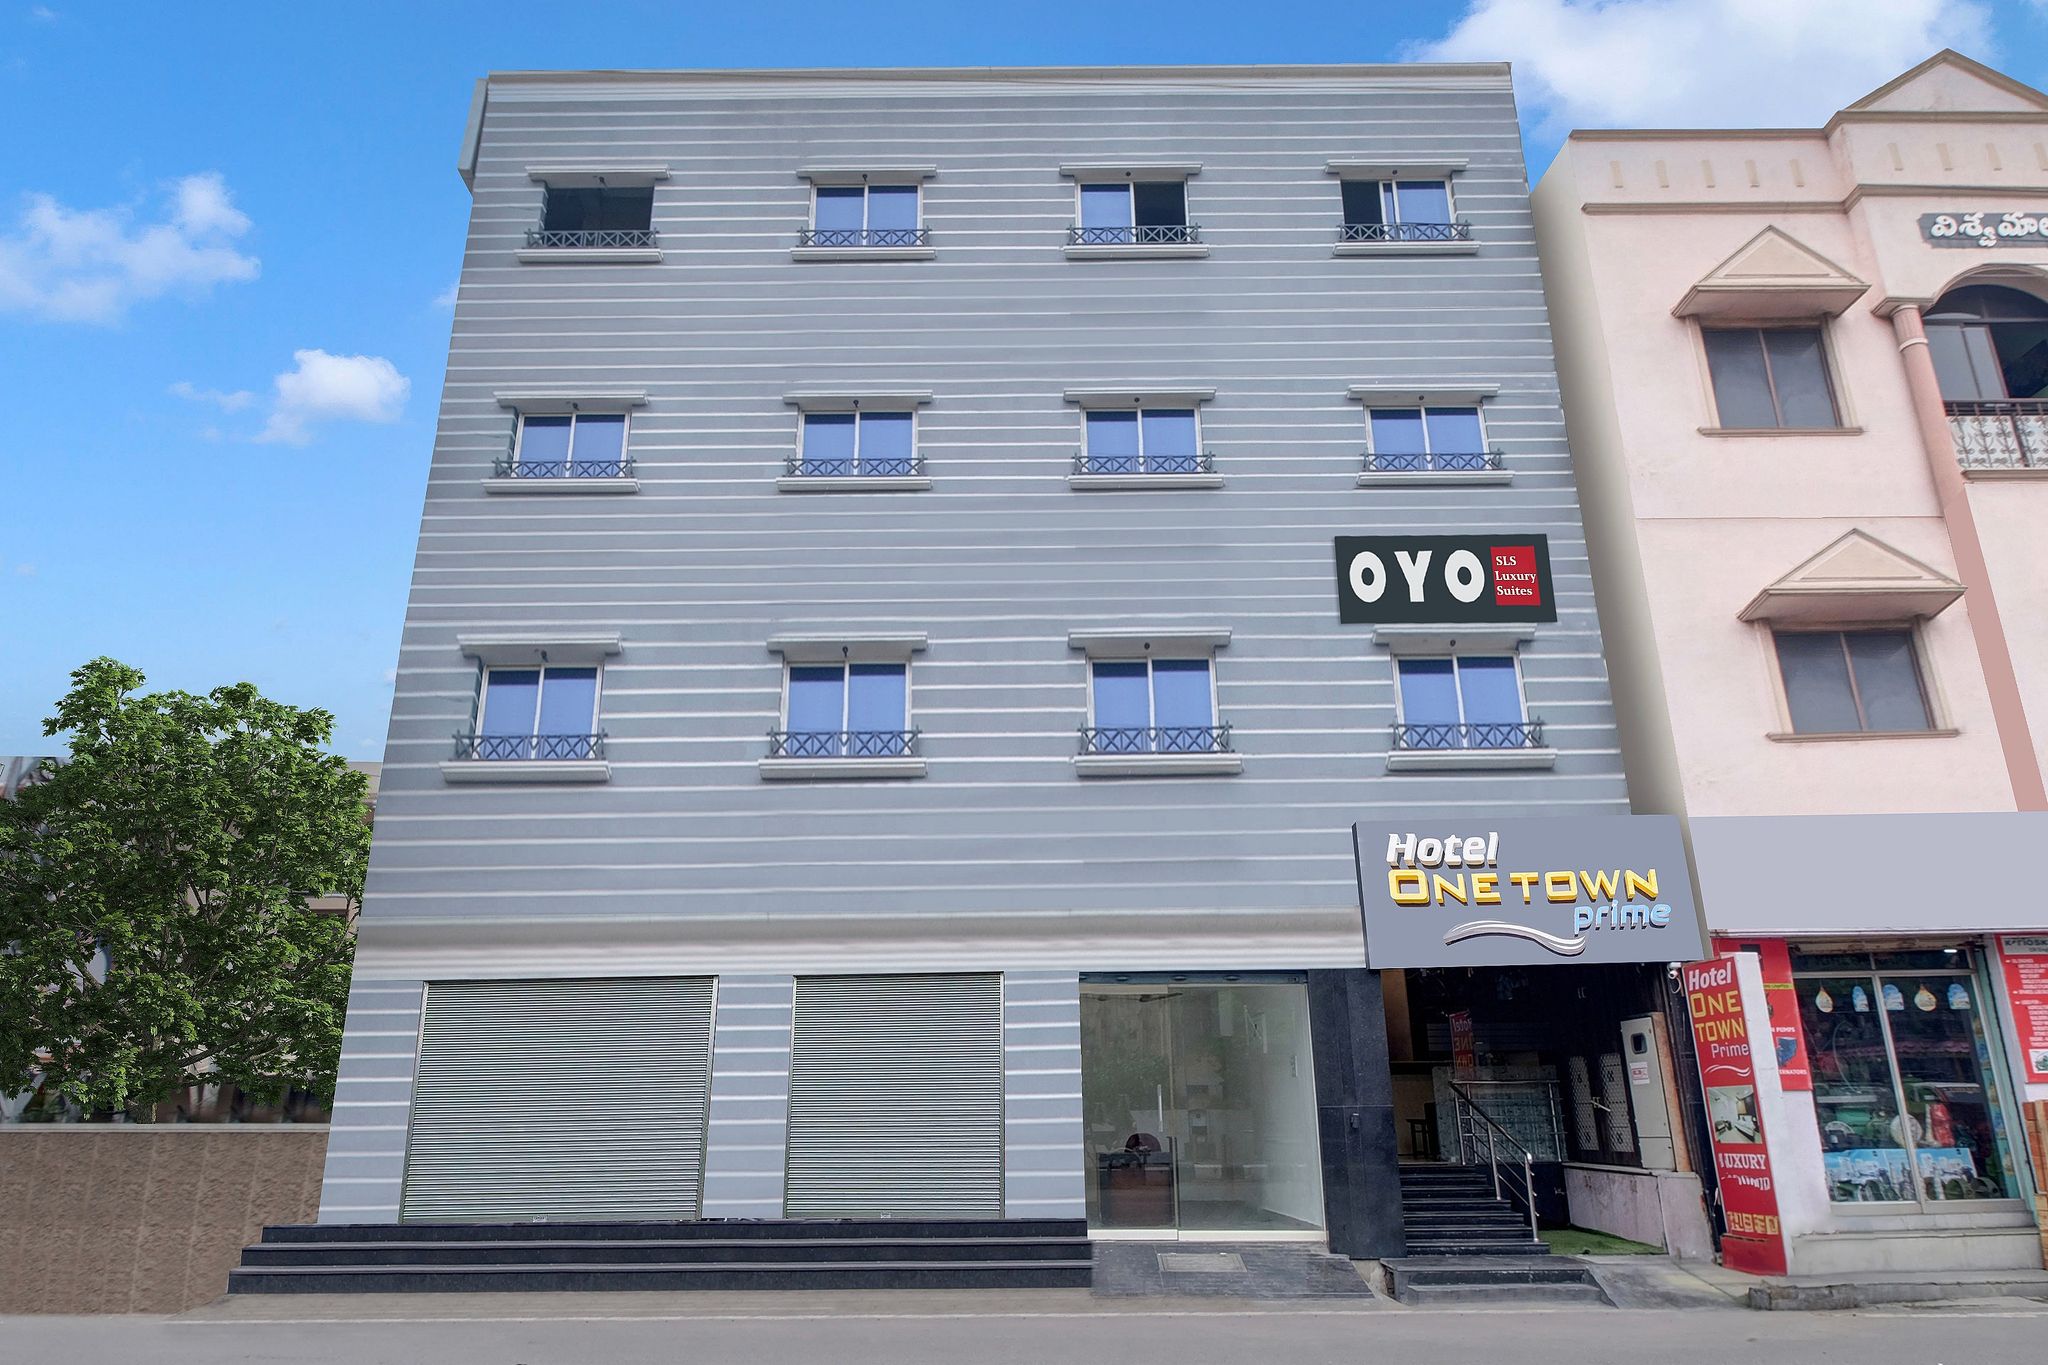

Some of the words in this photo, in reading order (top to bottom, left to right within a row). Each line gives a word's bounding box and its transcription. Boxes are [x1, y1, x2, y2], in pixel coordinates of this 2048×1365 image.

[1495, 556, 1517, 566] SLS
[1349, 549, 1485, 603] OYO
[1495, 570, 1537, 583] Luxury
[1496, 585, 1533, 596] Suites
[1386, 831, 1499, 867] Hotel
[1387, 869, 1502, 905] ONE
[1510, 868, 1660, 903] TOWN
[1573, 899, 1672, 936] prime
[1688, 961, 1732, 991] Hotel
[1690, 990, 1743, 1018] ONE
[1695, 1017, 1745, 1043] TOWN
[1710, 1043, 1750, 1059] Prime
